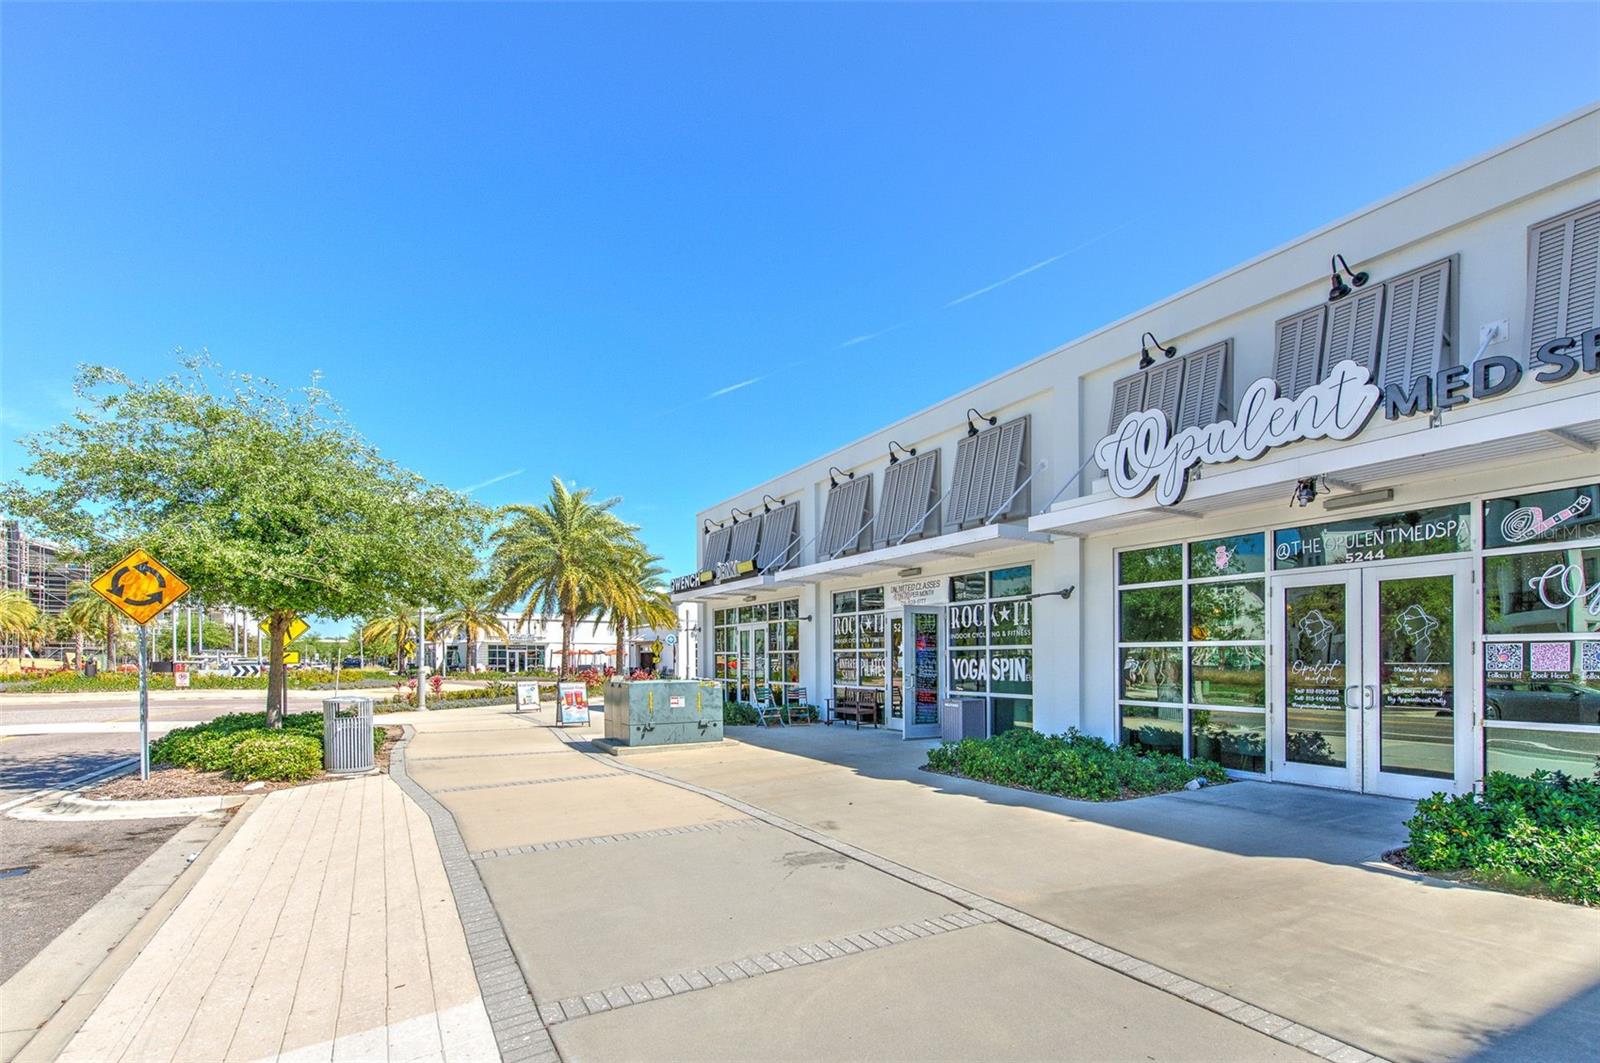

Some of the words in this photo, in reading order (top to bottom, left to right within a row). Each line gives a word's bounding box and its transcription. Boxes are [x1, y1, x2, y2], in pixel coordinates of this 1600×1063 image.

[1094, 360, 1383, 506] Opulent
[1385, 355, 1524, 421] MED
[1345, 549, 1385, 563] 5244
[916, 580, 941, 590] CLASSES
[1013, 601, 1032, 626] IT
[952, 658, 987, 680] YOGA
[991, 658, 1026, 682] SPIN
